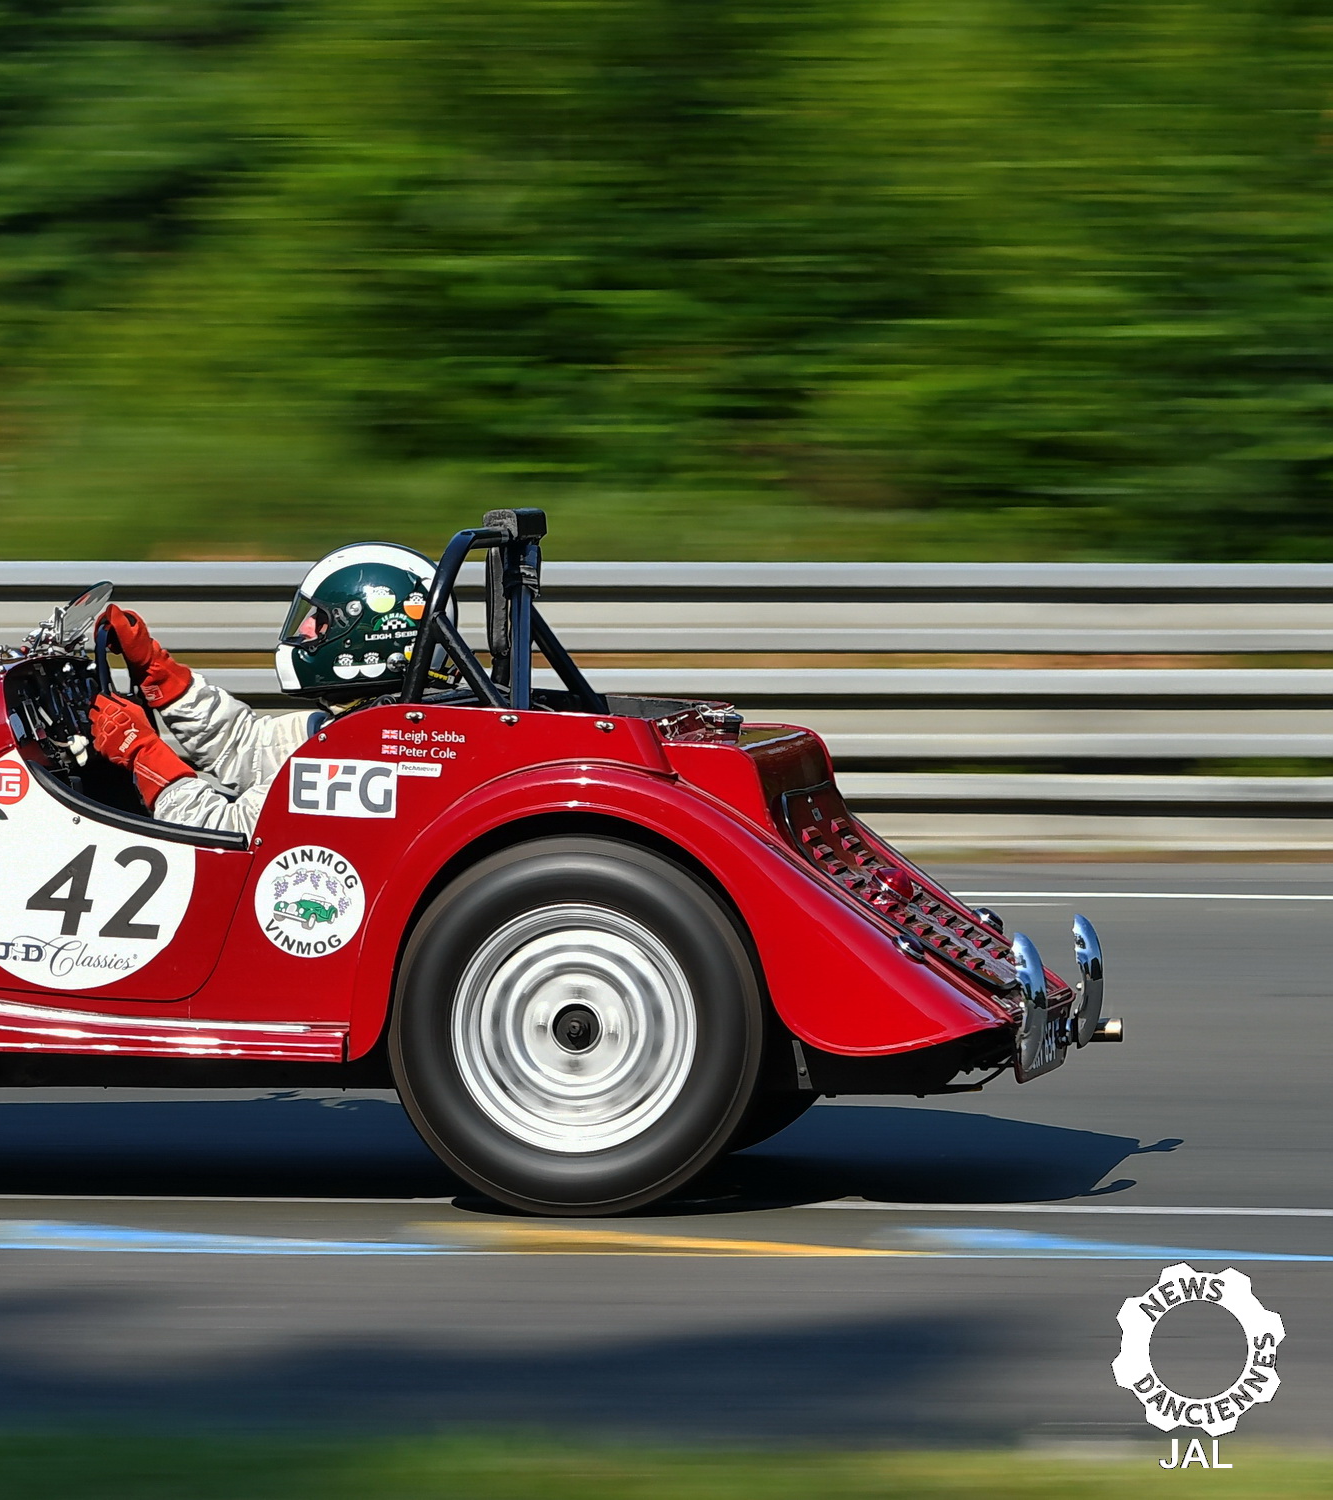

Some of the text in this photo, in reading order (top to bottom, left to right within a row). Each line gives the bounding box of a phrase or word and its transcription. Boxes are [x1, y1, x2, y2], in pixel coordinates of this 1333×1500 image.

[365, 630, 418, 641] LEIGH SEBB
[398, 730, 466, 745] Leigh Sebba
[398, 745, 457, 759] Peter Cole
[292, 762, 393, 814] EFG
[276, 848, 358, 889] VINMOG
[25, 844, 169, 940] 42
[265, 918, 342, 955] VINMOG
